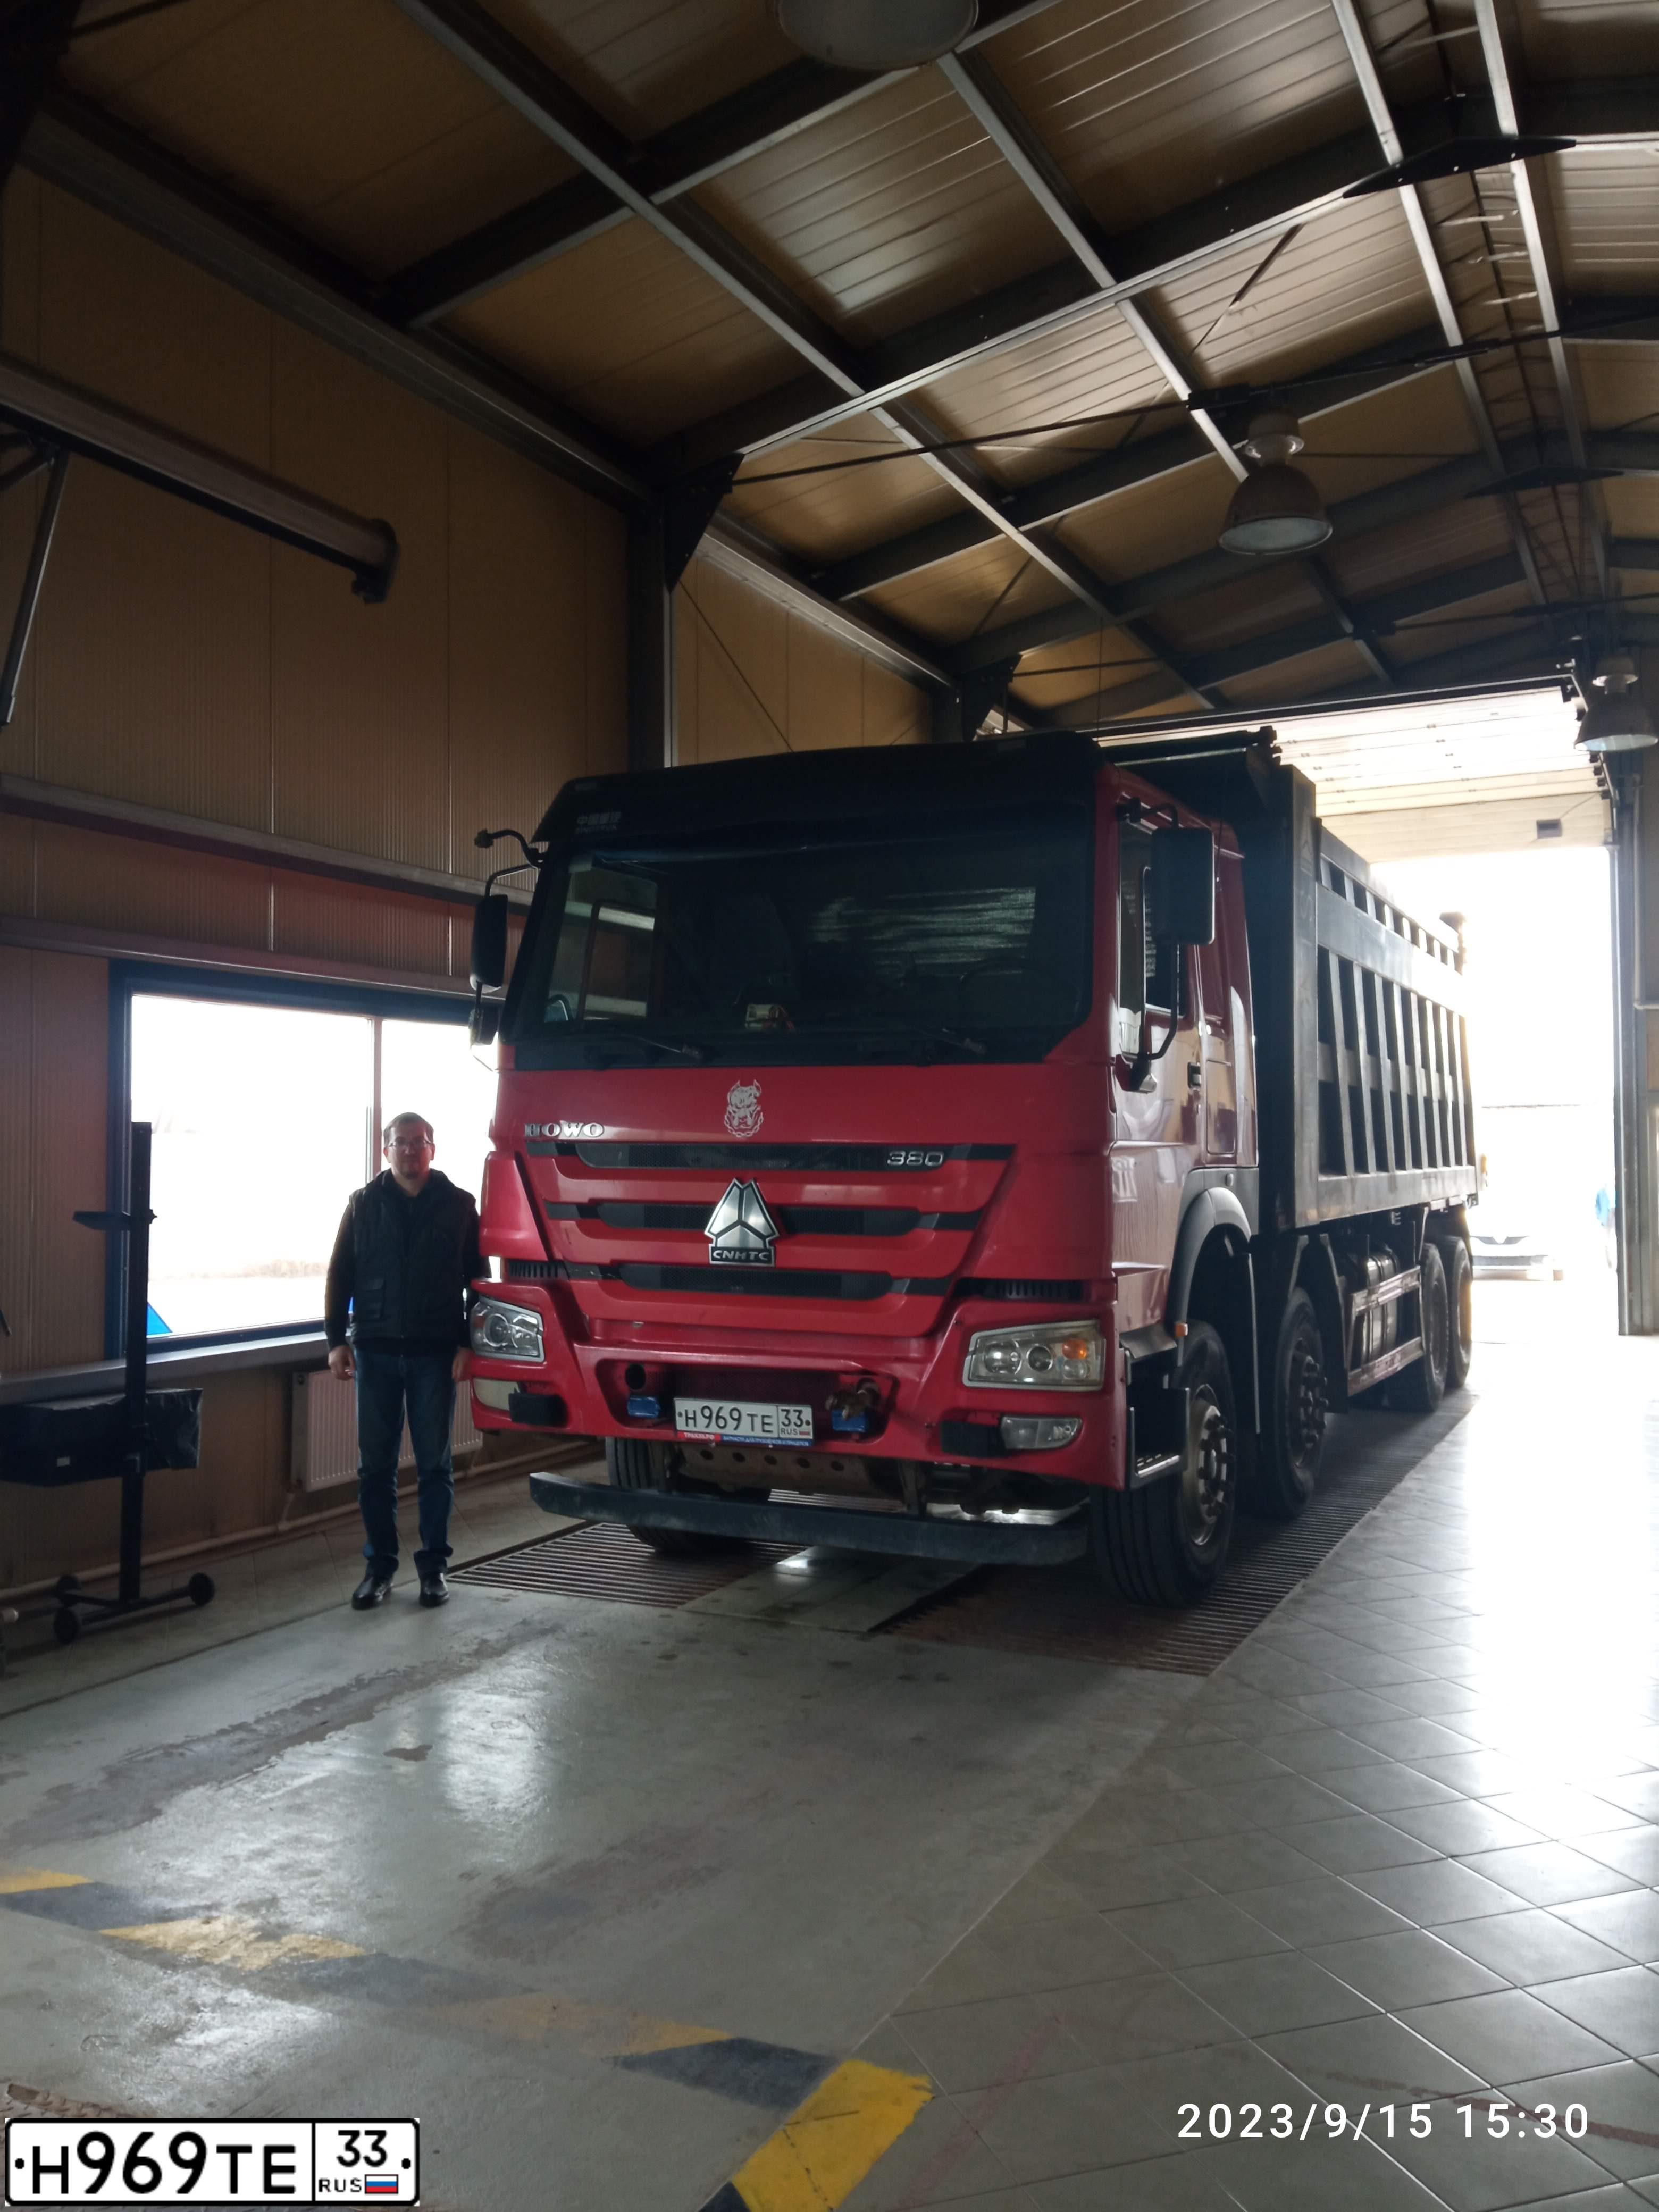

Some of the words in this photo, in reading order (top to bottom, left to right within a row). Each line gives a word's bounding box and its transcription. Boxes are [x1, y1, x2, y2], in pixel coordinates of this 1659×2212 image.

[524, 1122, 604, 1137] HOWO
[887, 1151, 944, 1166] 380
[713, 1250, 769, 1260] CNHTC
[781, 1409, 804, 1428] 33
